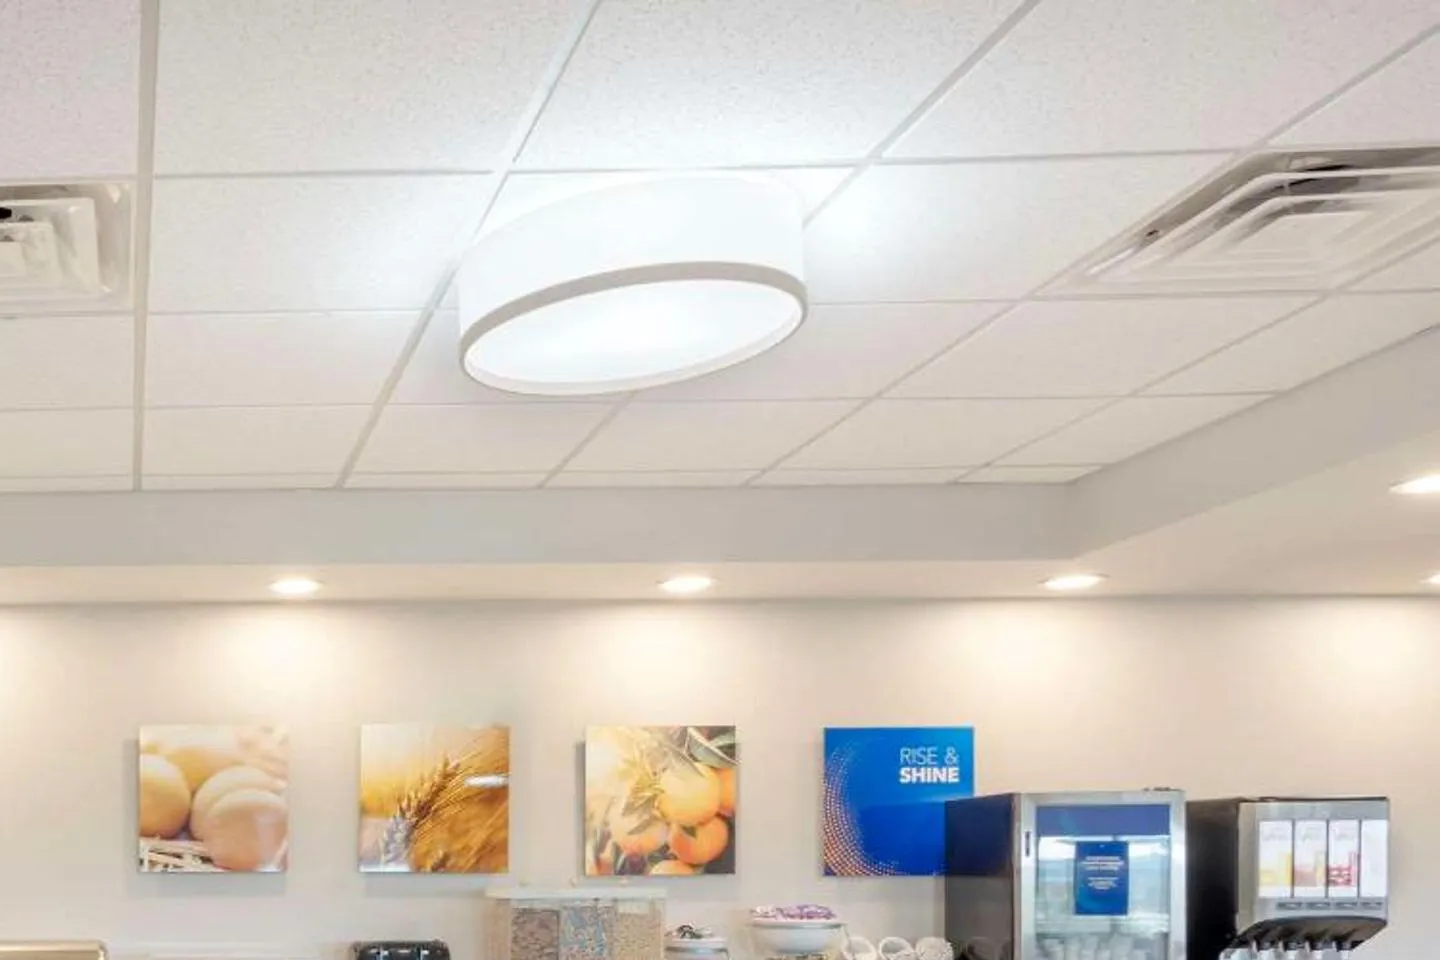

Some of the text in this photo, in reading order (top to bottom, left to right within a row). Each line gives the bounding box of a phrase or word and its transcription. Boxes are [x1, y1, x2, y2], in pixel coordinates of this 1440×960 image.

[899, 746, 960, 765] RISE &
[899, 767, 960, 784] SHINE
